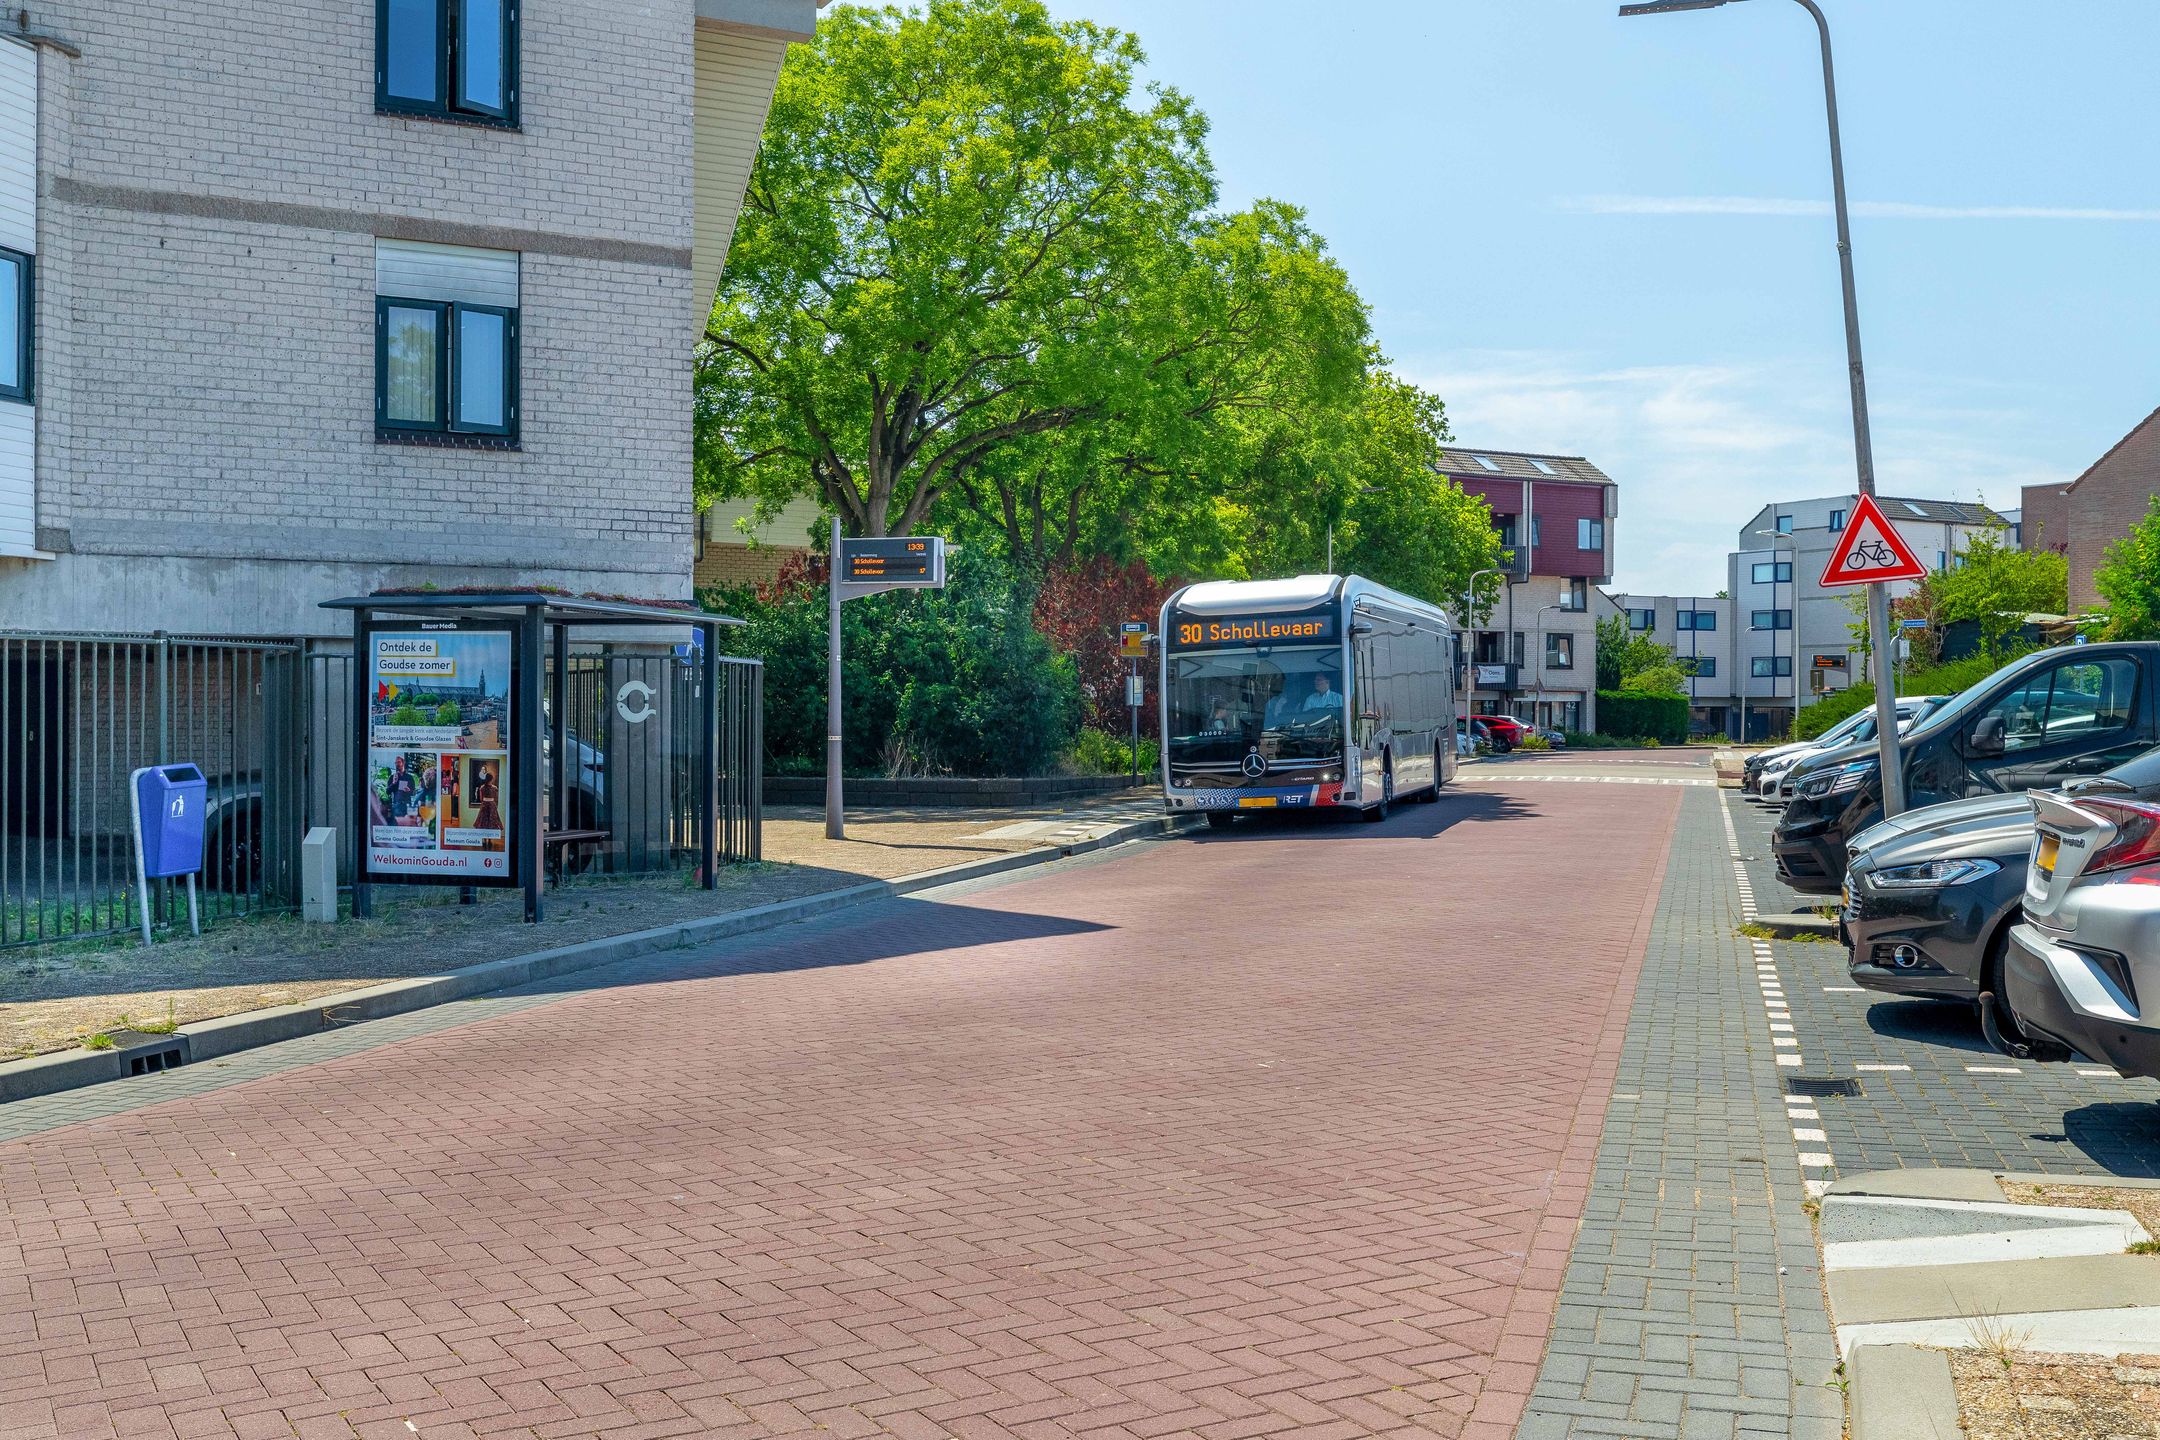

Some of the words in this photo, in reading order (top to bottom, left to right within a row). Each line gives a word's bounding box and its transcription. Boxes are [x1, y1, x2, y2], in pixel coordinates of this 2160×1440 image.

[1179, 623, 1202, 644] 30
[1209, 620, 1324, 641] Schollevaar
[379, 642, 416, 652] Ontdek
[419, 642, 432, 652] de
[379, 659, 416, 669] Goudse
[419, 662, 451, 670] zomer
[1483, 700, 1494, 709] 44
[1566, 701, 1577, 710] 42
[1283, 794, 1303, 803] RET
[373, 854, 468, 867] WelkominGouda.nl
